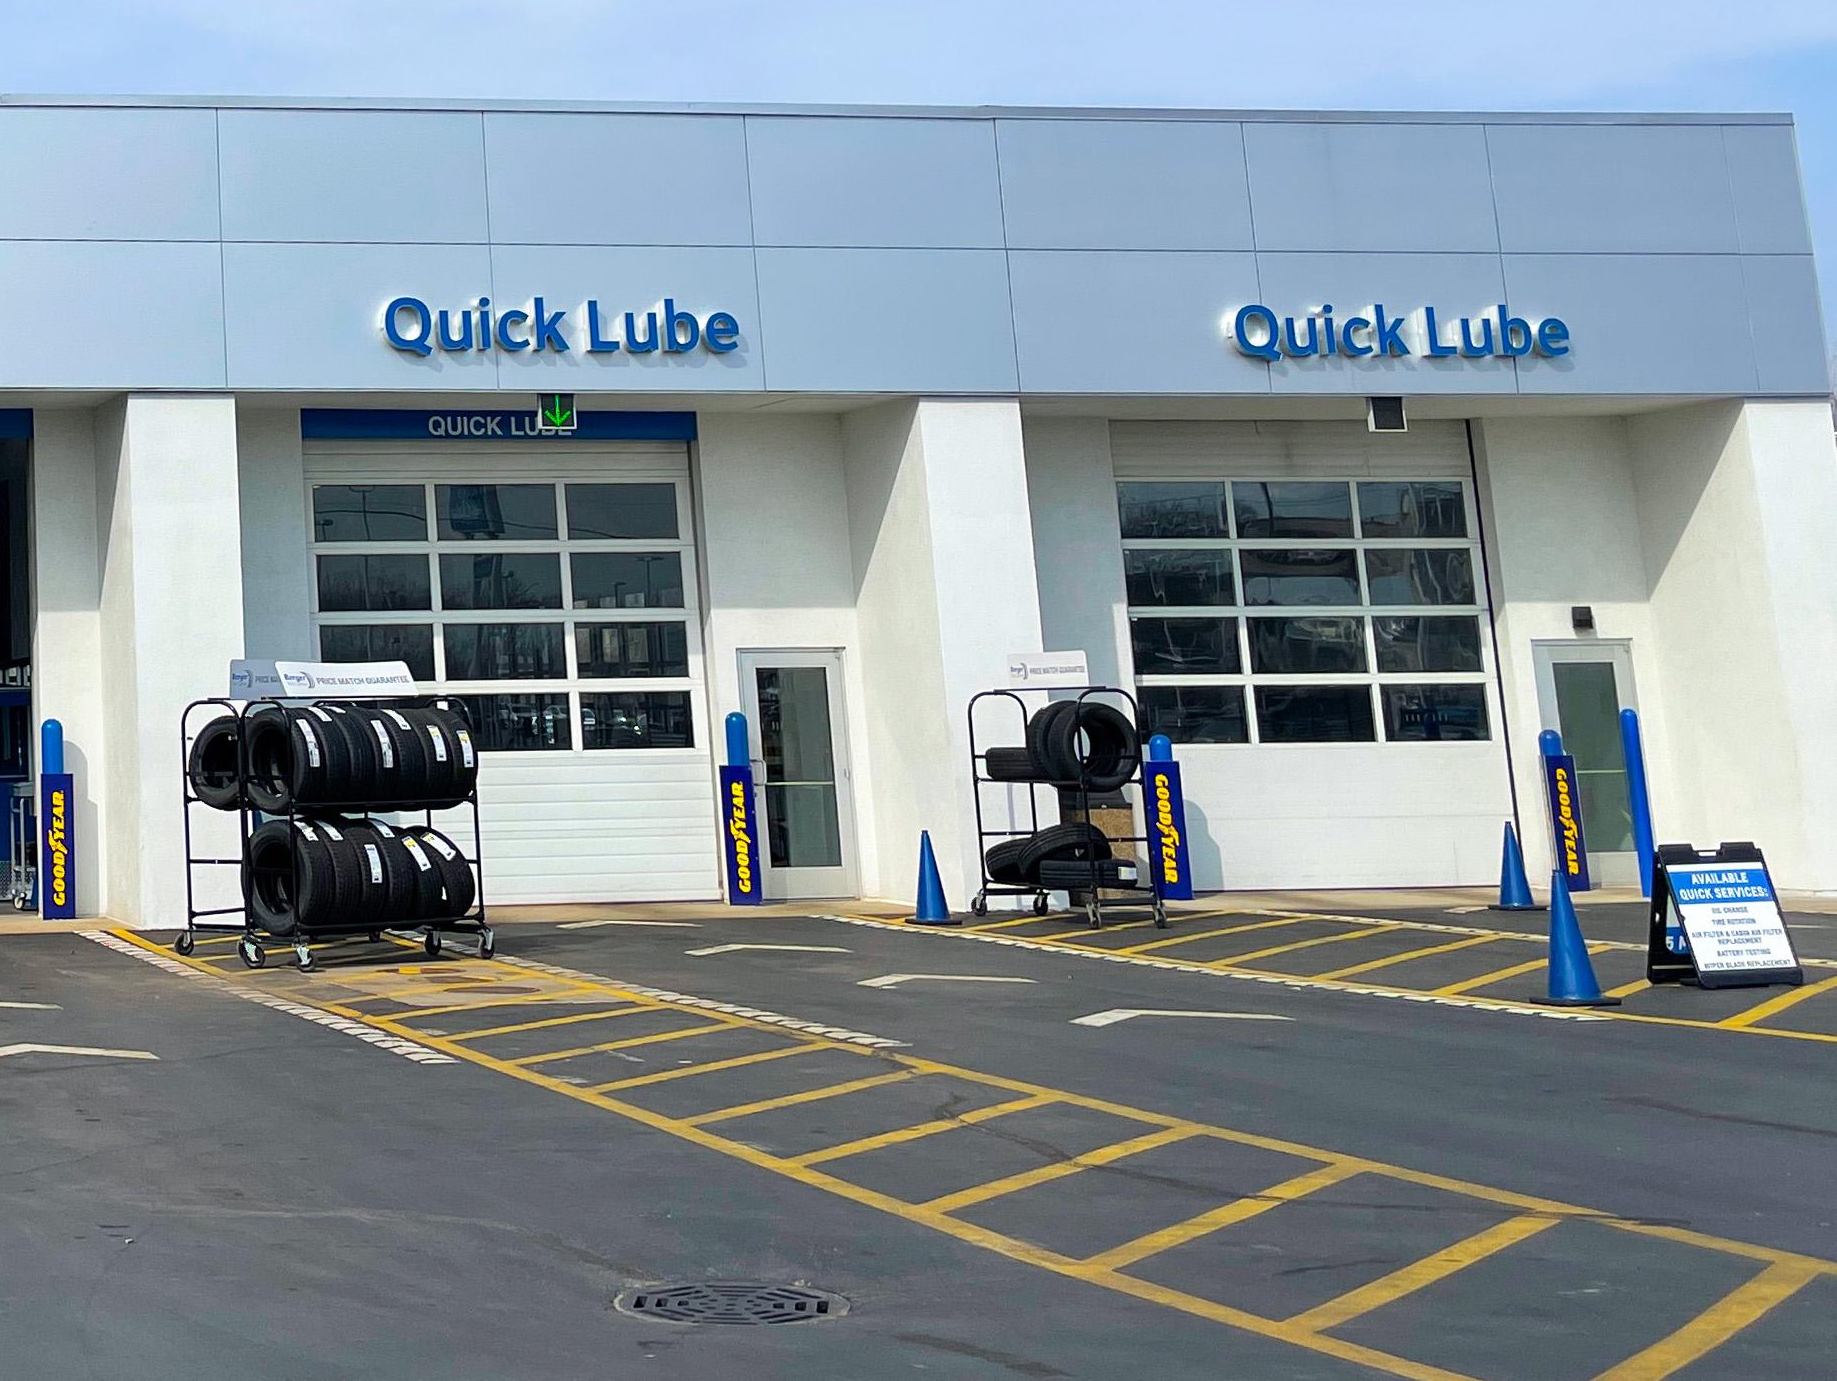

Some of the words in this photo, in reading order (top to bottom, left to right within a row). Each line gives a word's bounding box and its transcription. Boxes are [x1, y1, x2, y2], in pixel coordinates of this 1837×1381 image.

[384, 297, 570, 356] Quick
[587, 298, 740, 354] Lube
[1235, 304, 1411, 362] Quick
[1425, 304, 1570, 358] Lube
[428, 416, 503, 436] QUICK
[510, 416, 573, 436] LU
[316, 677, 337, 685] PRICE
[337, 677, 364, 685] MATCH
[365, 675, 411, 685] GUARANTEE
[48, 790, 68, 906] GOODYEAR
[730, 781, 751, 893] GOODYEAR
[1155, 774, 1179, 884] GOODYEAR
[1556, 768, 1579, 875] GOODYEAR
[1679, 888, 1713, 901] QUICK
[1691, 872, 1749, 885] AVAILABLE
